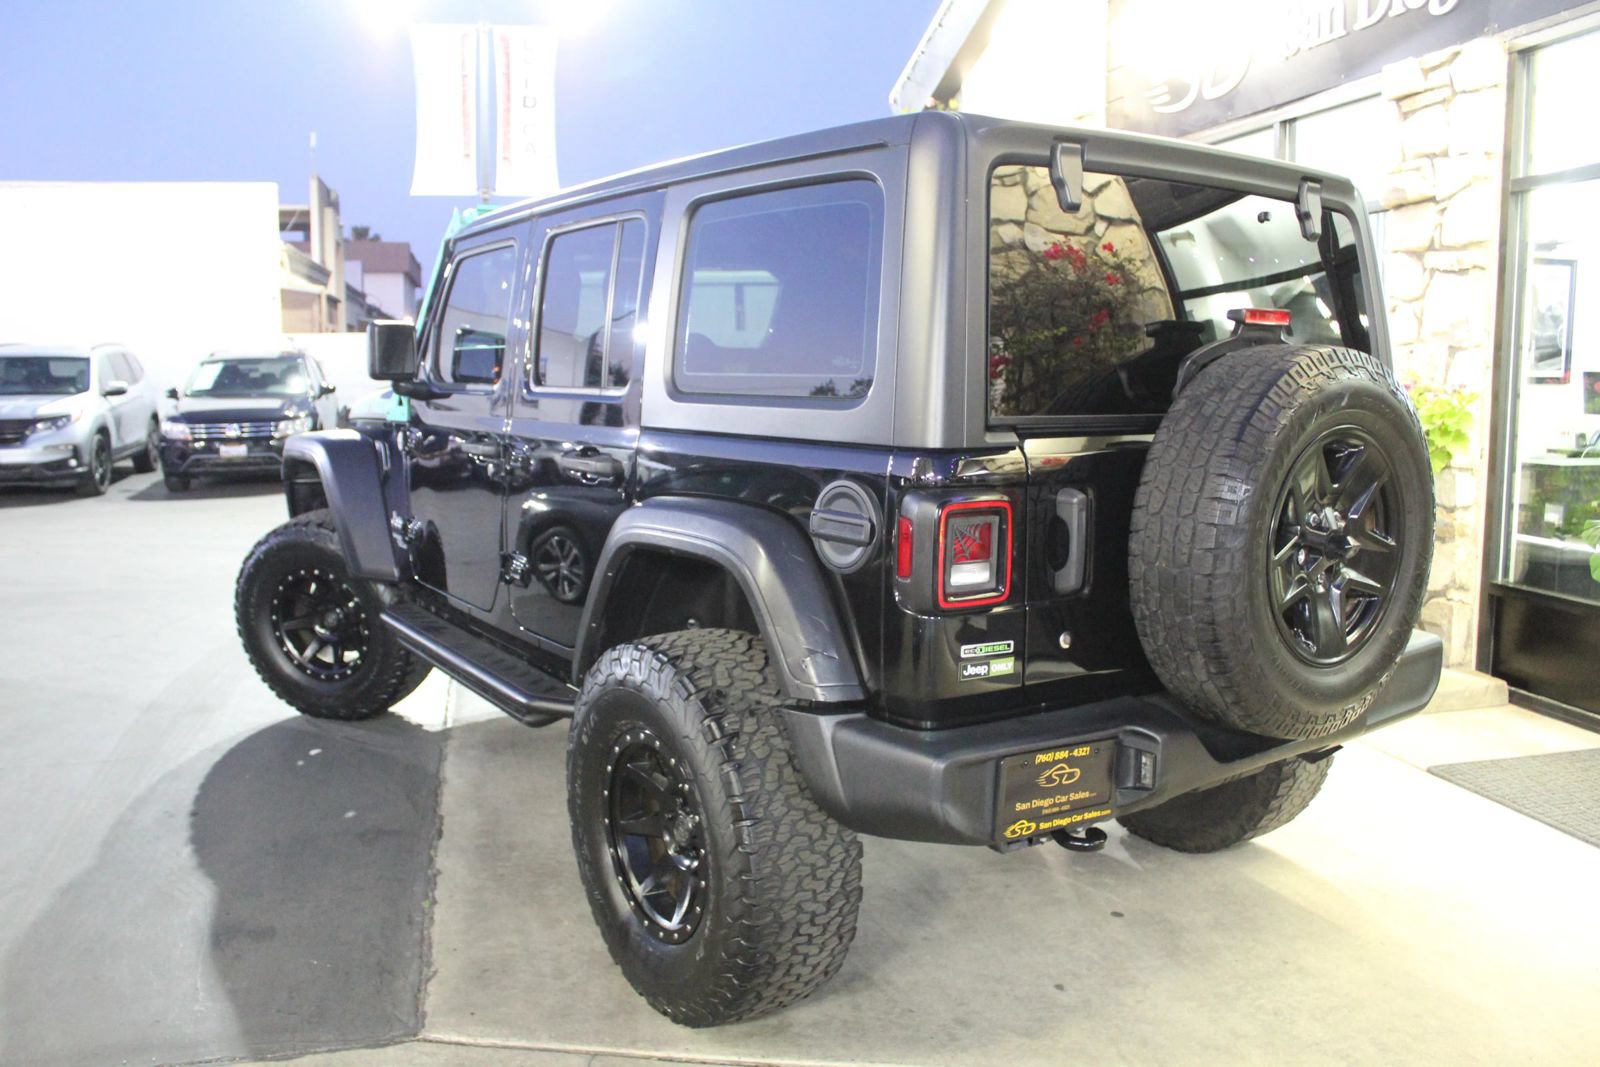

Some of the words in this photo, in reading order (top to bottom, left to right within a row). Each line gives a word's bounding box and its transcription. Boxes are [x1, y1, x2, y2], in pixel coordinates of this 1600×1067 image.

[963, 664, 989, 676] Jeep
[992, 663, 1013, 672] ONLY
[1035, 752, 1054, 765] (760)
[1015, 802, 1031, 811] San
[1031, 796, 1054, 808] Diego
[1055, 795, 1069, 804] Car
[1039, 822, 1053, 830] San
[1053, 817, 1072, 827] Diego
[1072, 814, 1083, 823] Car
